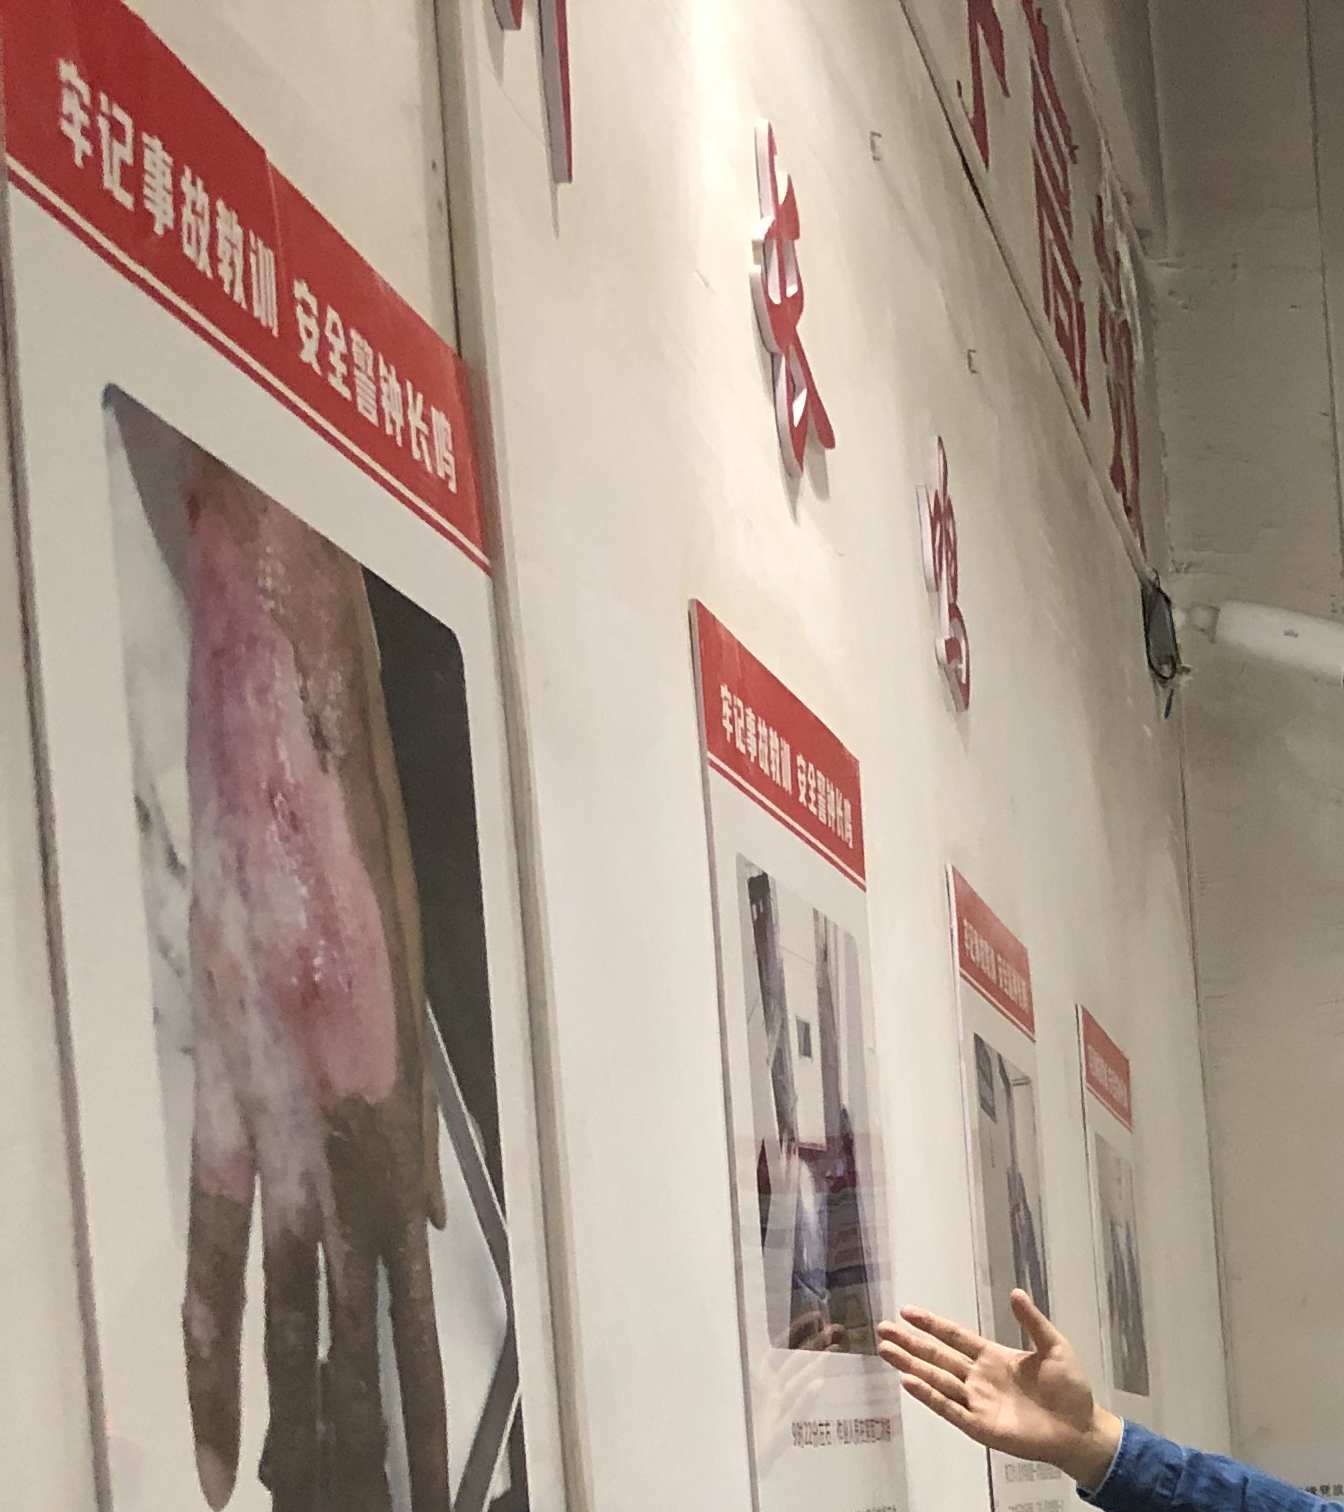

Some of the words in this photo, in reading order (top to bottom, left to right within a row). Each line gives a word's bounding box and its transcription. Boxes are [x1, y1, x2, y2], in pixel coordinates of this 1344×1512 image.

[58, 57, 279, 338] 牢记事故教训
[293, 279, 457, 494] 安全警钟长鸣
[720, 684, 792, 795] 牢记事故教训
[796, 753, 854, 849] 安全警钟长鸣
